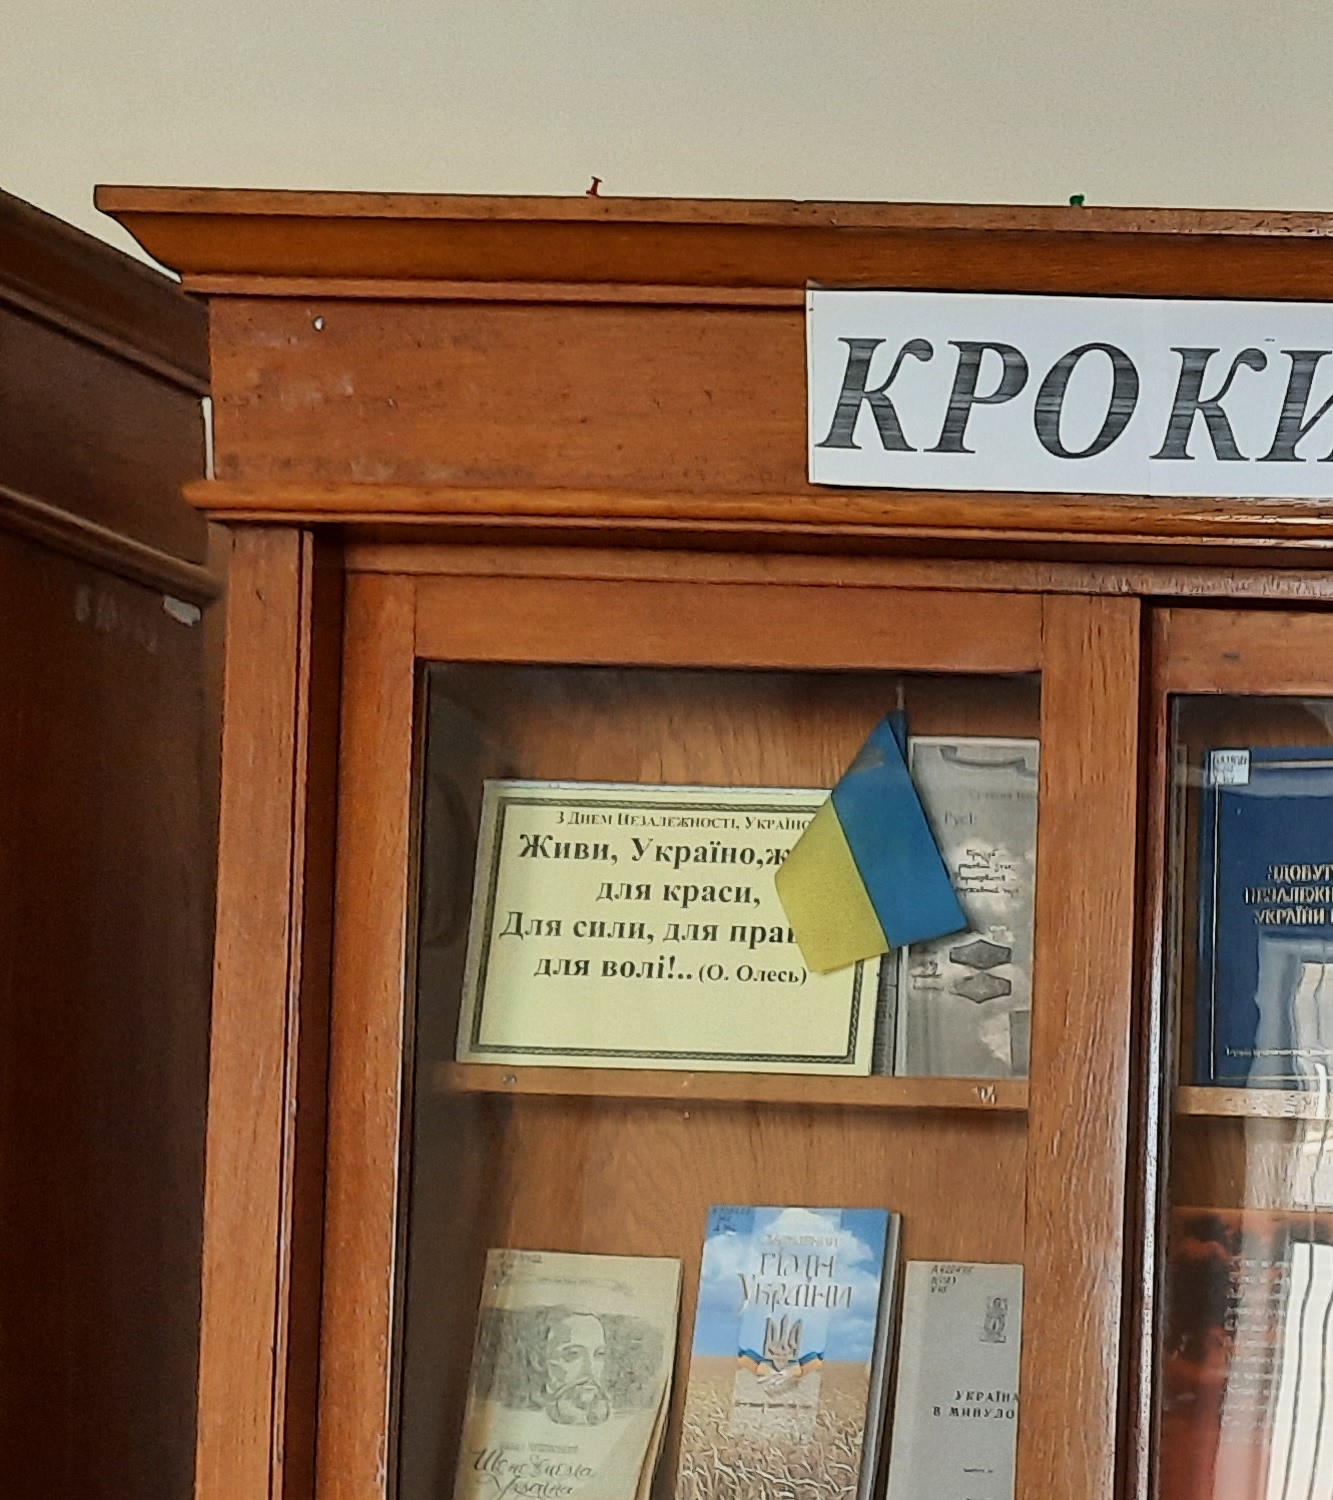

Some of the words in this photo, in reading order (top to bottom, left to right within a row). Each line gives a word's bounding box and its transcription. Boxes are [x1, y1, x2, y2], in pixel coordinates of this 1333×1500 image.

[518, 834, 618, 864] Живи,
[596, 882, 652, 902] для
[663, 883, 762, 909] краси,
[499, 911, 563, 940] Для
[573, 920, 654, 944] сили,
[662, 923, 719, 942] для
[533, 957, 591, 978] для
[601, 956, 693, 980] волі!..
[698, 964, 730, 983] (О.
[736, 965, 808, 986] Олесь)
[933, 1406, 942, 1417] В
